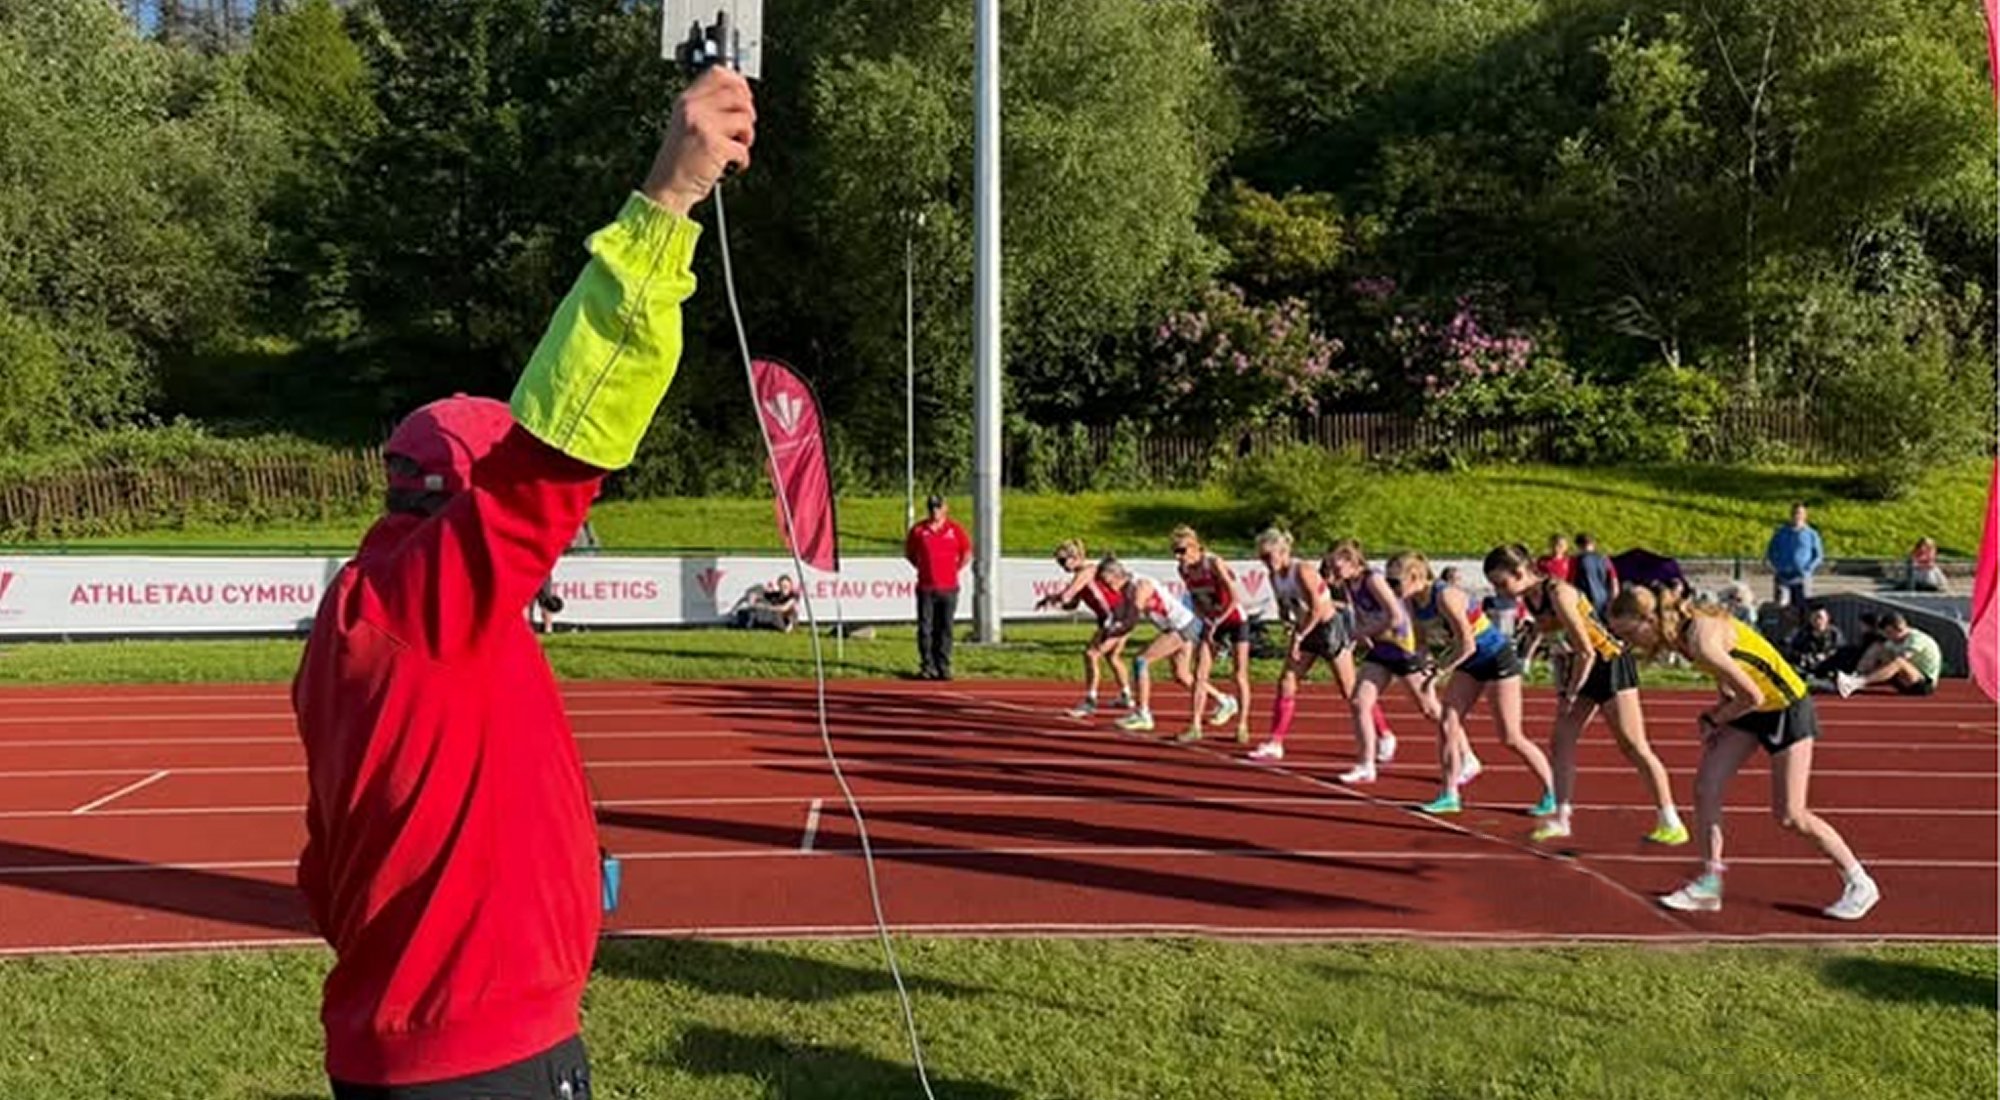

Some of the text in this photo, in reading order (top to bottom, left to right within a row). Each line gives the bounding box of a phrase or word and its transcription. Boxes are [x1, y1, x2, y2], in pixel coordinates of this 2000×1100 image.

[70, 584, 316, 605] ATHLETAU CYMRU
[551, 581, 658, 600] THLETICS
[871, 580, 914, 599] CYM
